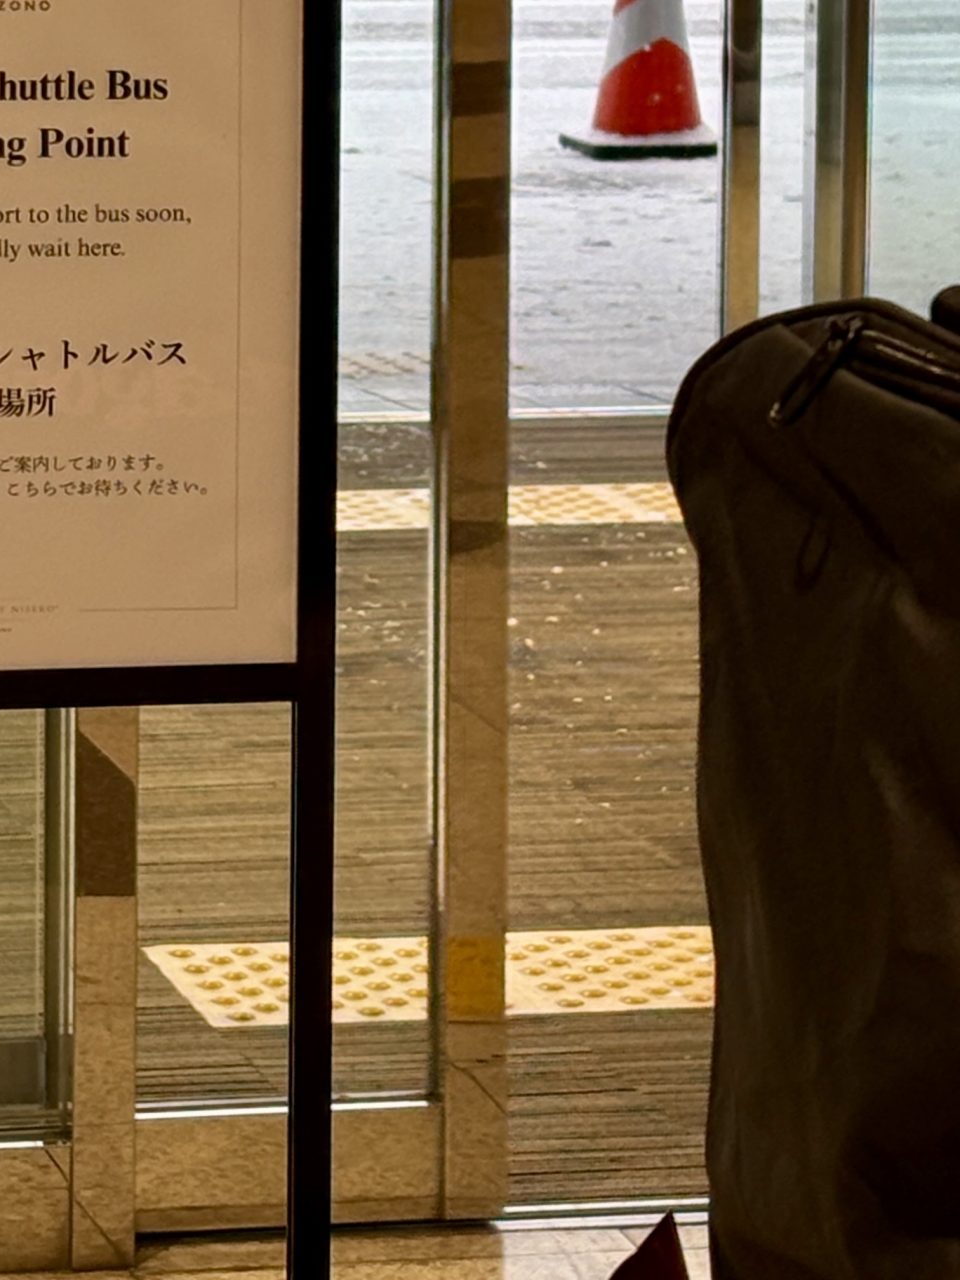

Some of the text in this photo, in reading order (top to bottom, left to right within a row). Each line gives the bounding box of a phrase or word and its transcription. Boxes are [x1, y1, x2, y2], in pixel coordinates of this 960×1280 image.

[105, 70, 169, 101] Bus
[38, 127, 130, 158] Point
[28, 206, 50, 223] to
[56, 205, 89, 223] the
[95, 204, 130, 222] bus
[135, 207, 192, 224] soon,
[28, 238, 71, 257] wait
[78, 238, 126, 257] here.
